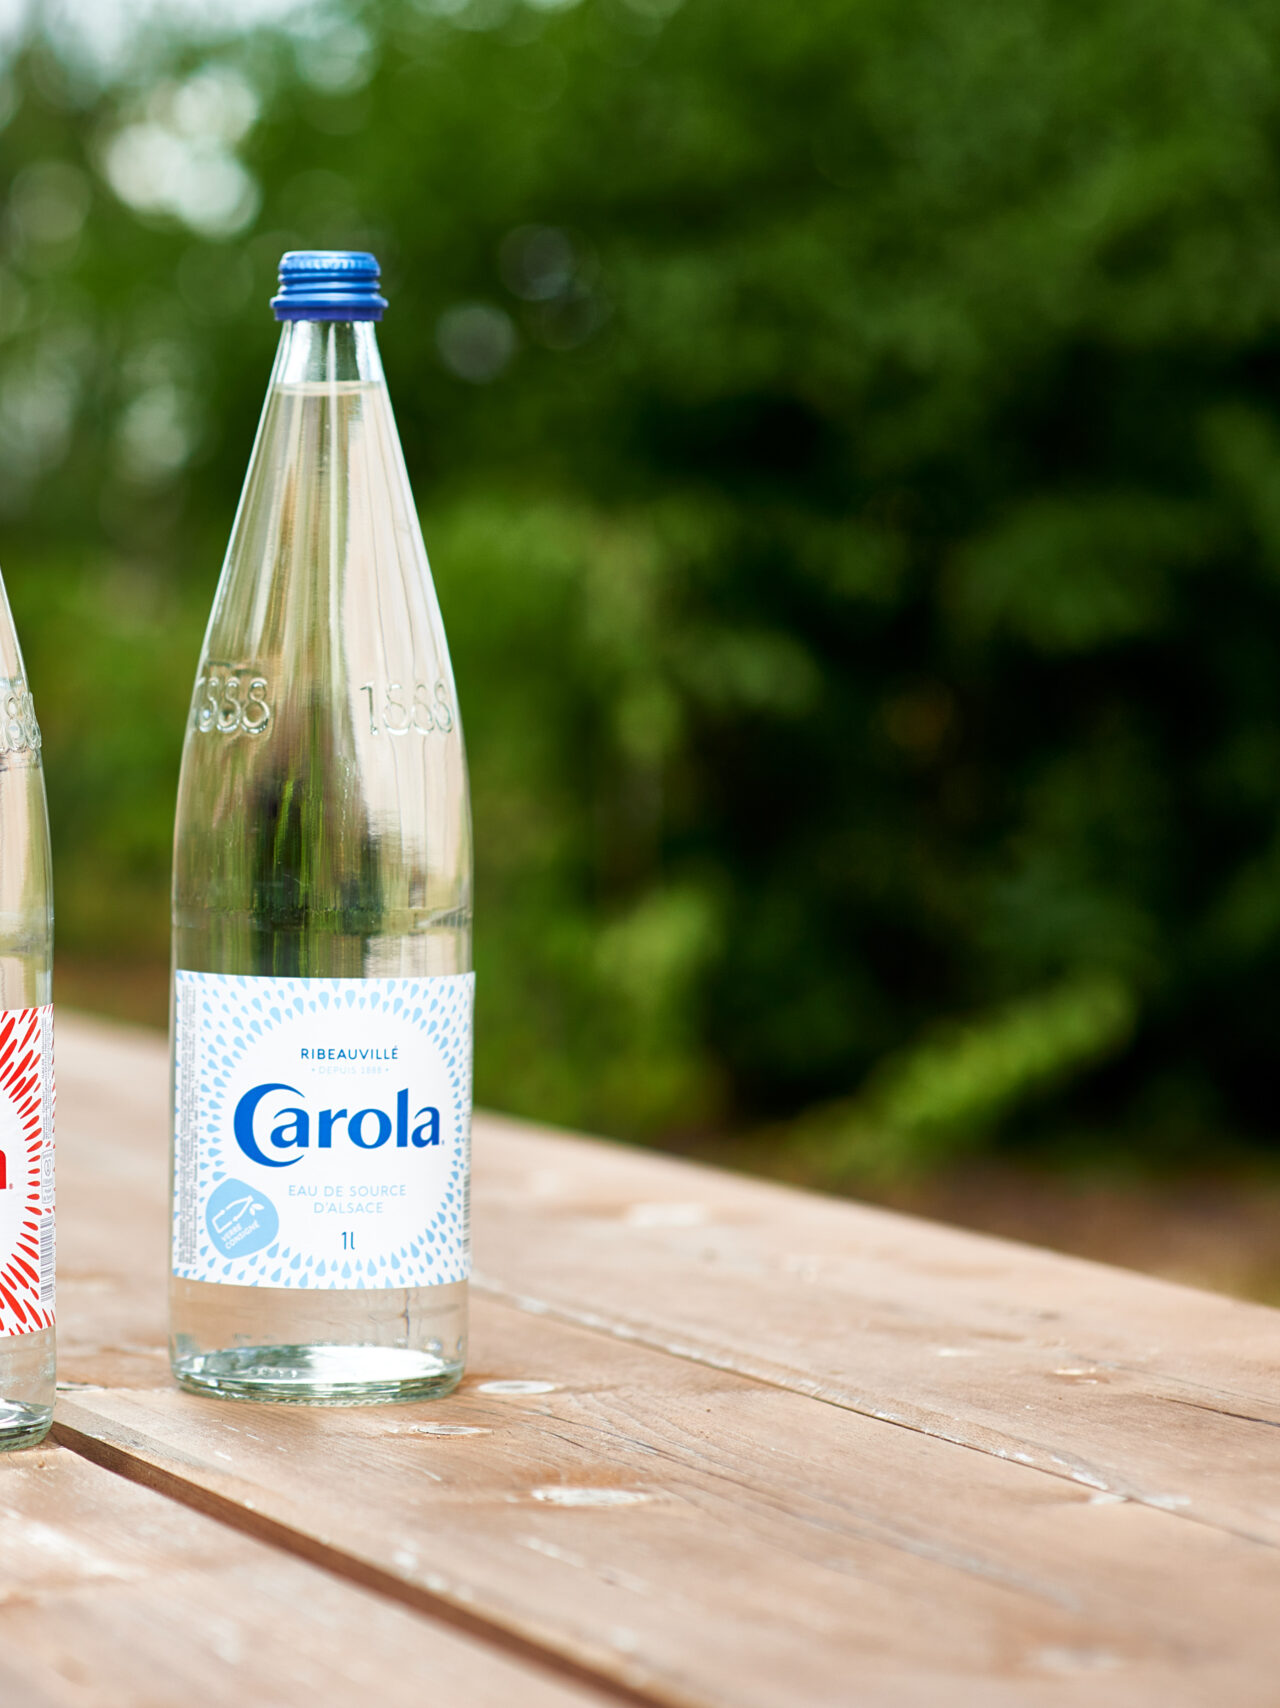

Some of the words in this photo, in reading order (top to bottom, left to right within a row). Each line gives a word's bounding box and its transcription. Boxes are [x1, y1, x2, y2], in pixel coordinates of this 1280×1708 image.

[300, 1045, 399, 1060] RIBEAUVILLÉ
[318, 1066, 357, 1075] DEPUIS
[233, 1082, 441, 1168] Carola
[288, 1184, 318, 1197] EAU
[324, 1185, 343, 1198] DE
[349, 1184, 407, 1197] SOURCE
[313, 1201, 384, 1214] D'ALSACE
